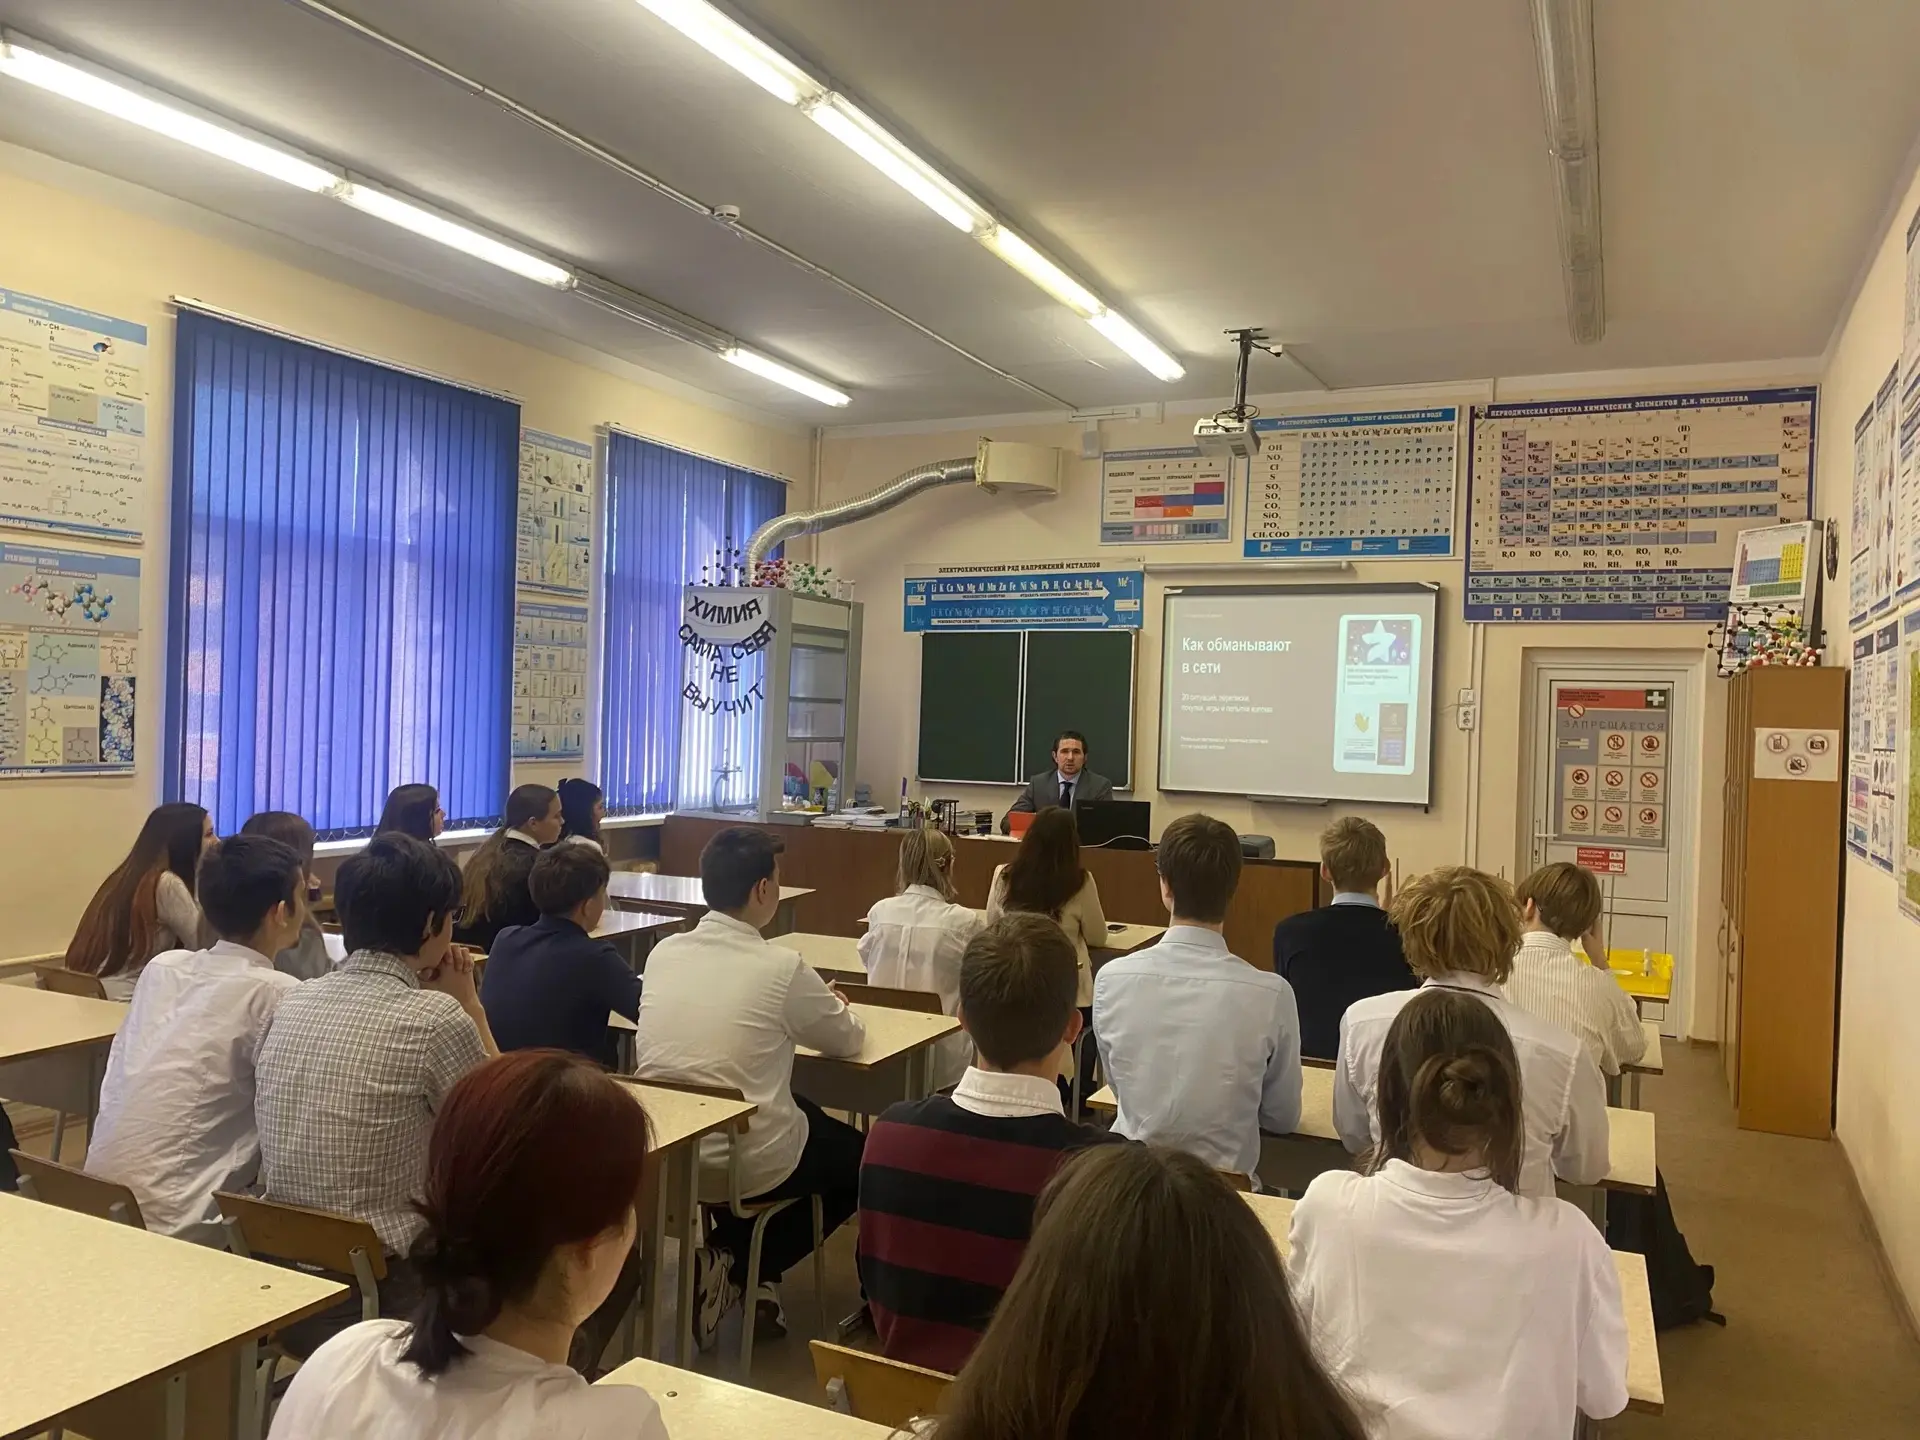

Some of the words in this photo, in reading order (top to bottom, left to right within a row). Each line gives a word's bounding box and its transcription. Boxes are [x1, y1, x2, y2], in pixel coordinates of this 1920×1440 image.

[1491, 408, 1547, 416] ПЕРИОДИЧЕСКАЯ
[1550, 406, 1582, 414] СИСТЕМА
[1584, 402, 1632, 412] ХИМИЧЕСКИХ
[1635, 399, 1678, 408] ЭЛЕМЕНТОВ
[1700, 396, 1748, 404] МЕНДЕЛЕЕВА
[938, 564, 1006, 574] ЭЛЕКТРОХИМИЧЕСКИЙ
[1020, 562, 1064, 570] НАПРЯЖЕНИЙ
[688, 596, 762, 624] ХИМИЯ
[678, 624, 724, 662] САМА
[1182, 638, 1204, 650] Как
[1207, 637, 1292, 652] обманывают
[710, 664, 738, 684] НЕ
[1182, 663, 1190, 674] в
[1193, 663, 1220, 674] сети
[683, 681, 764, 717] ВЫУЧИТ
[1564, 720, 1665, 731] ЗАПРЕЩАЕТСЯ
